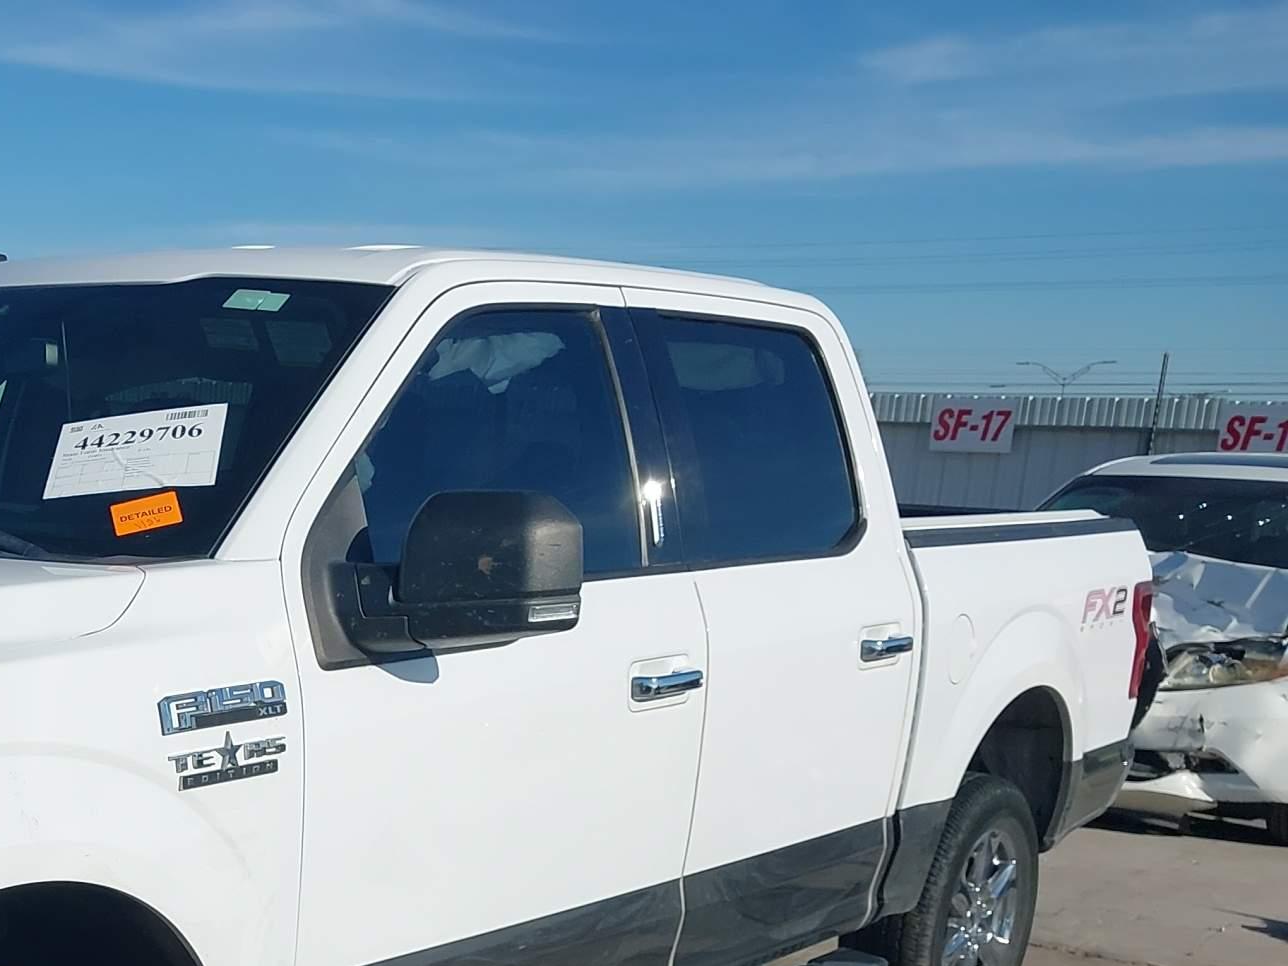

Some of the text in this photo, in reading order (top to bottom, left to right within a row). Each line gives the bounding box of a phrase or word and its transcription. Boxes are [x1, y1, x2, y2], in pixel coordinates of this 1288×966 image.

[74, 422, 204, 450] 44229706
[933, 408, 1012, 442] SF-17
[1221, 415, 1288, 452] SF-1
[120, 505, 172, 522] DETAILED
[1081, 587, 1128, 624] FX2
[258, 704, 283, 716] XLT
[187, 759, 274, 786] EDITION
